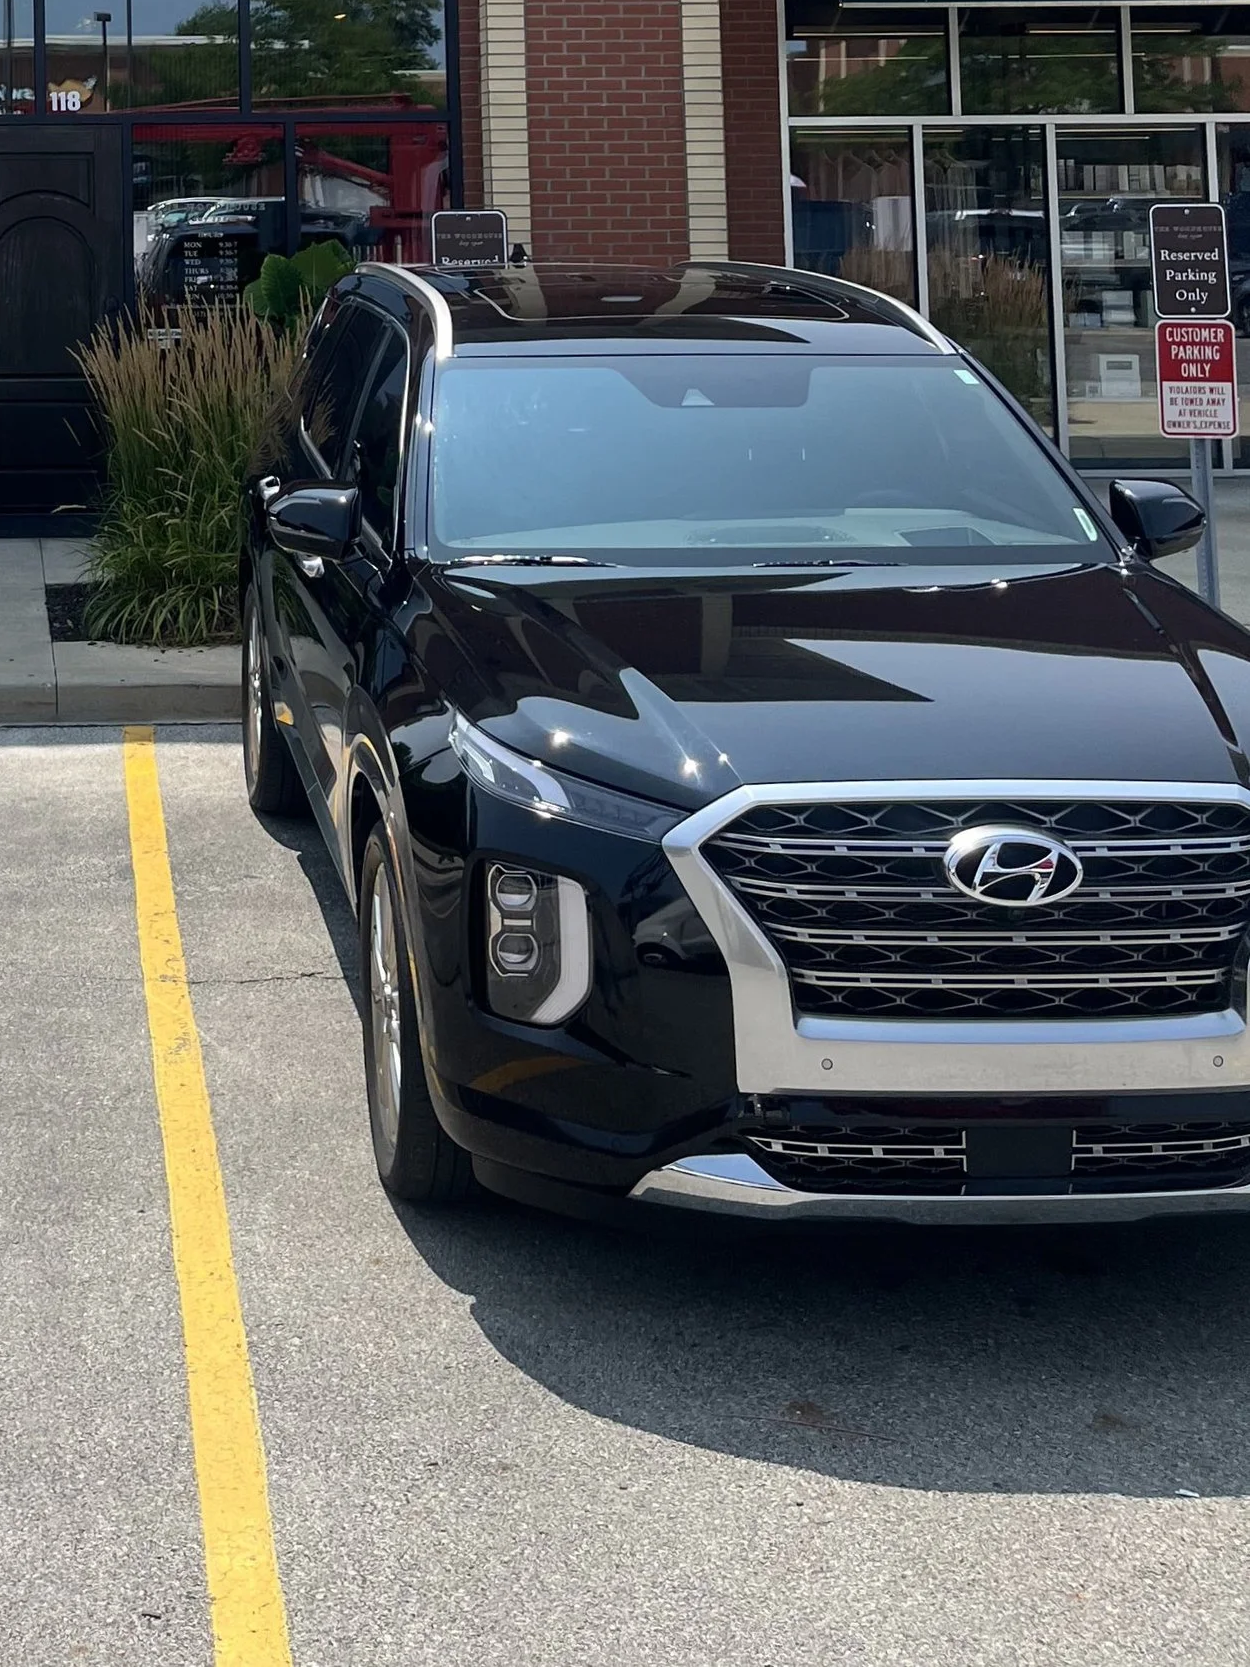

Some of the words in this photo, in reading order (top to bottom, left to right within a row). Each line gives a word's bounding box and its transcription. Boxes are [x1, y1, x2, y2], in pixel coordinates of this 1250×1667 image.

[50, 91, 81, 111] 118
[183, 241, 203, 249] MON
[1160, 248, 1219, 261] Reserved
[1165, 268, 1217, 284] Parking
[1175, 287, 1209, 304] Only
[1165, 327, 1224, 343] CUSTOMER
[1171, 345, 1221, 360] PARKING
[1181, 362, 1211, 377] ONLY
[1168, 385, 1207, 395] VIOLATORS
[1208, 386, 1226, 395] WILL
[1169, 397, 1178, 406] BE
[1181, 397, 1204, 406] TOWED
[1206, 398, 1226, 407] AWAY
[1178, 409, 1187, 417] AT
[1188, 409, 1218, 418] VEHICLE
[1166, 419, 1198, 429] OWNER'S
[1199, 420, 1231, 430] EXPENSE
